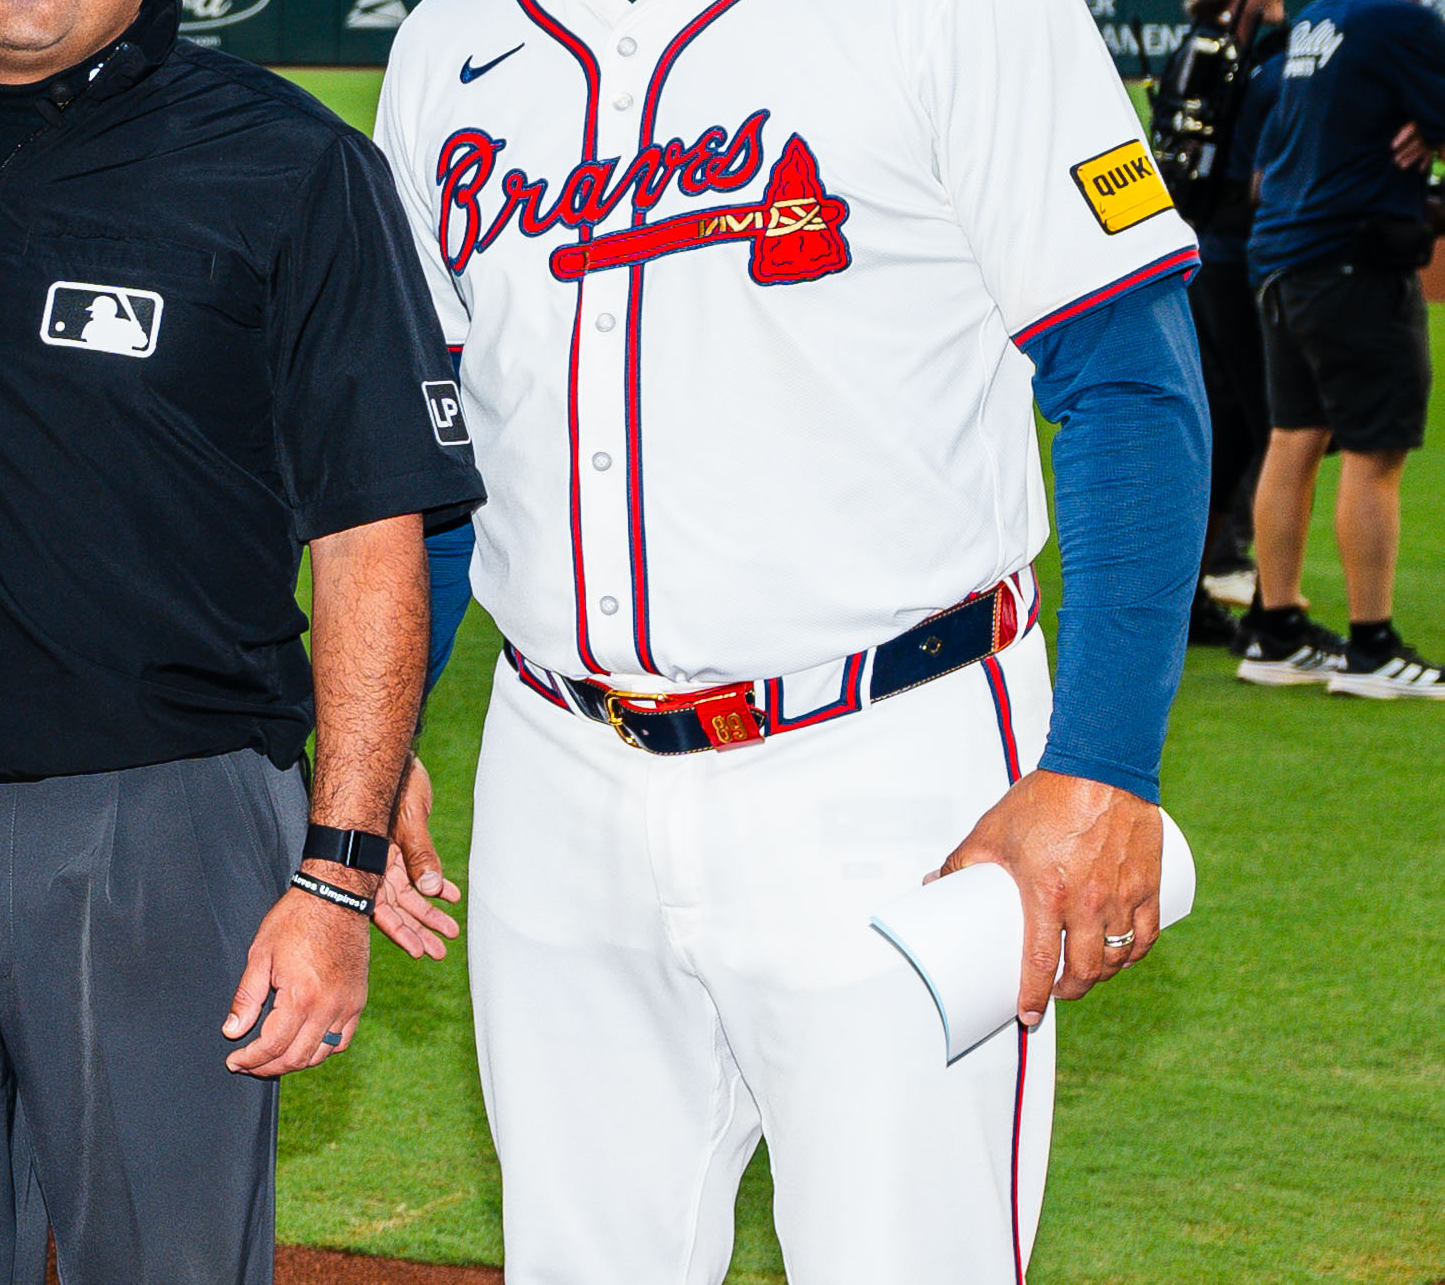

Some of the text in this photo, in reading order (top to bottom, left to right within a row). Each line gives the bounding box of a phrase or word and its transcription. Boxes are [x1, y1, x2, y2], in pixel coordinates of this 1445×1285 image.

[1092, 156, 1157, 197] QUIK
[436, 109, 770, 276] Braves
[430, 397, 459, 428] LP
[712, 712, 747, 743] 89
[319, 884, 361, 908] Umpires
